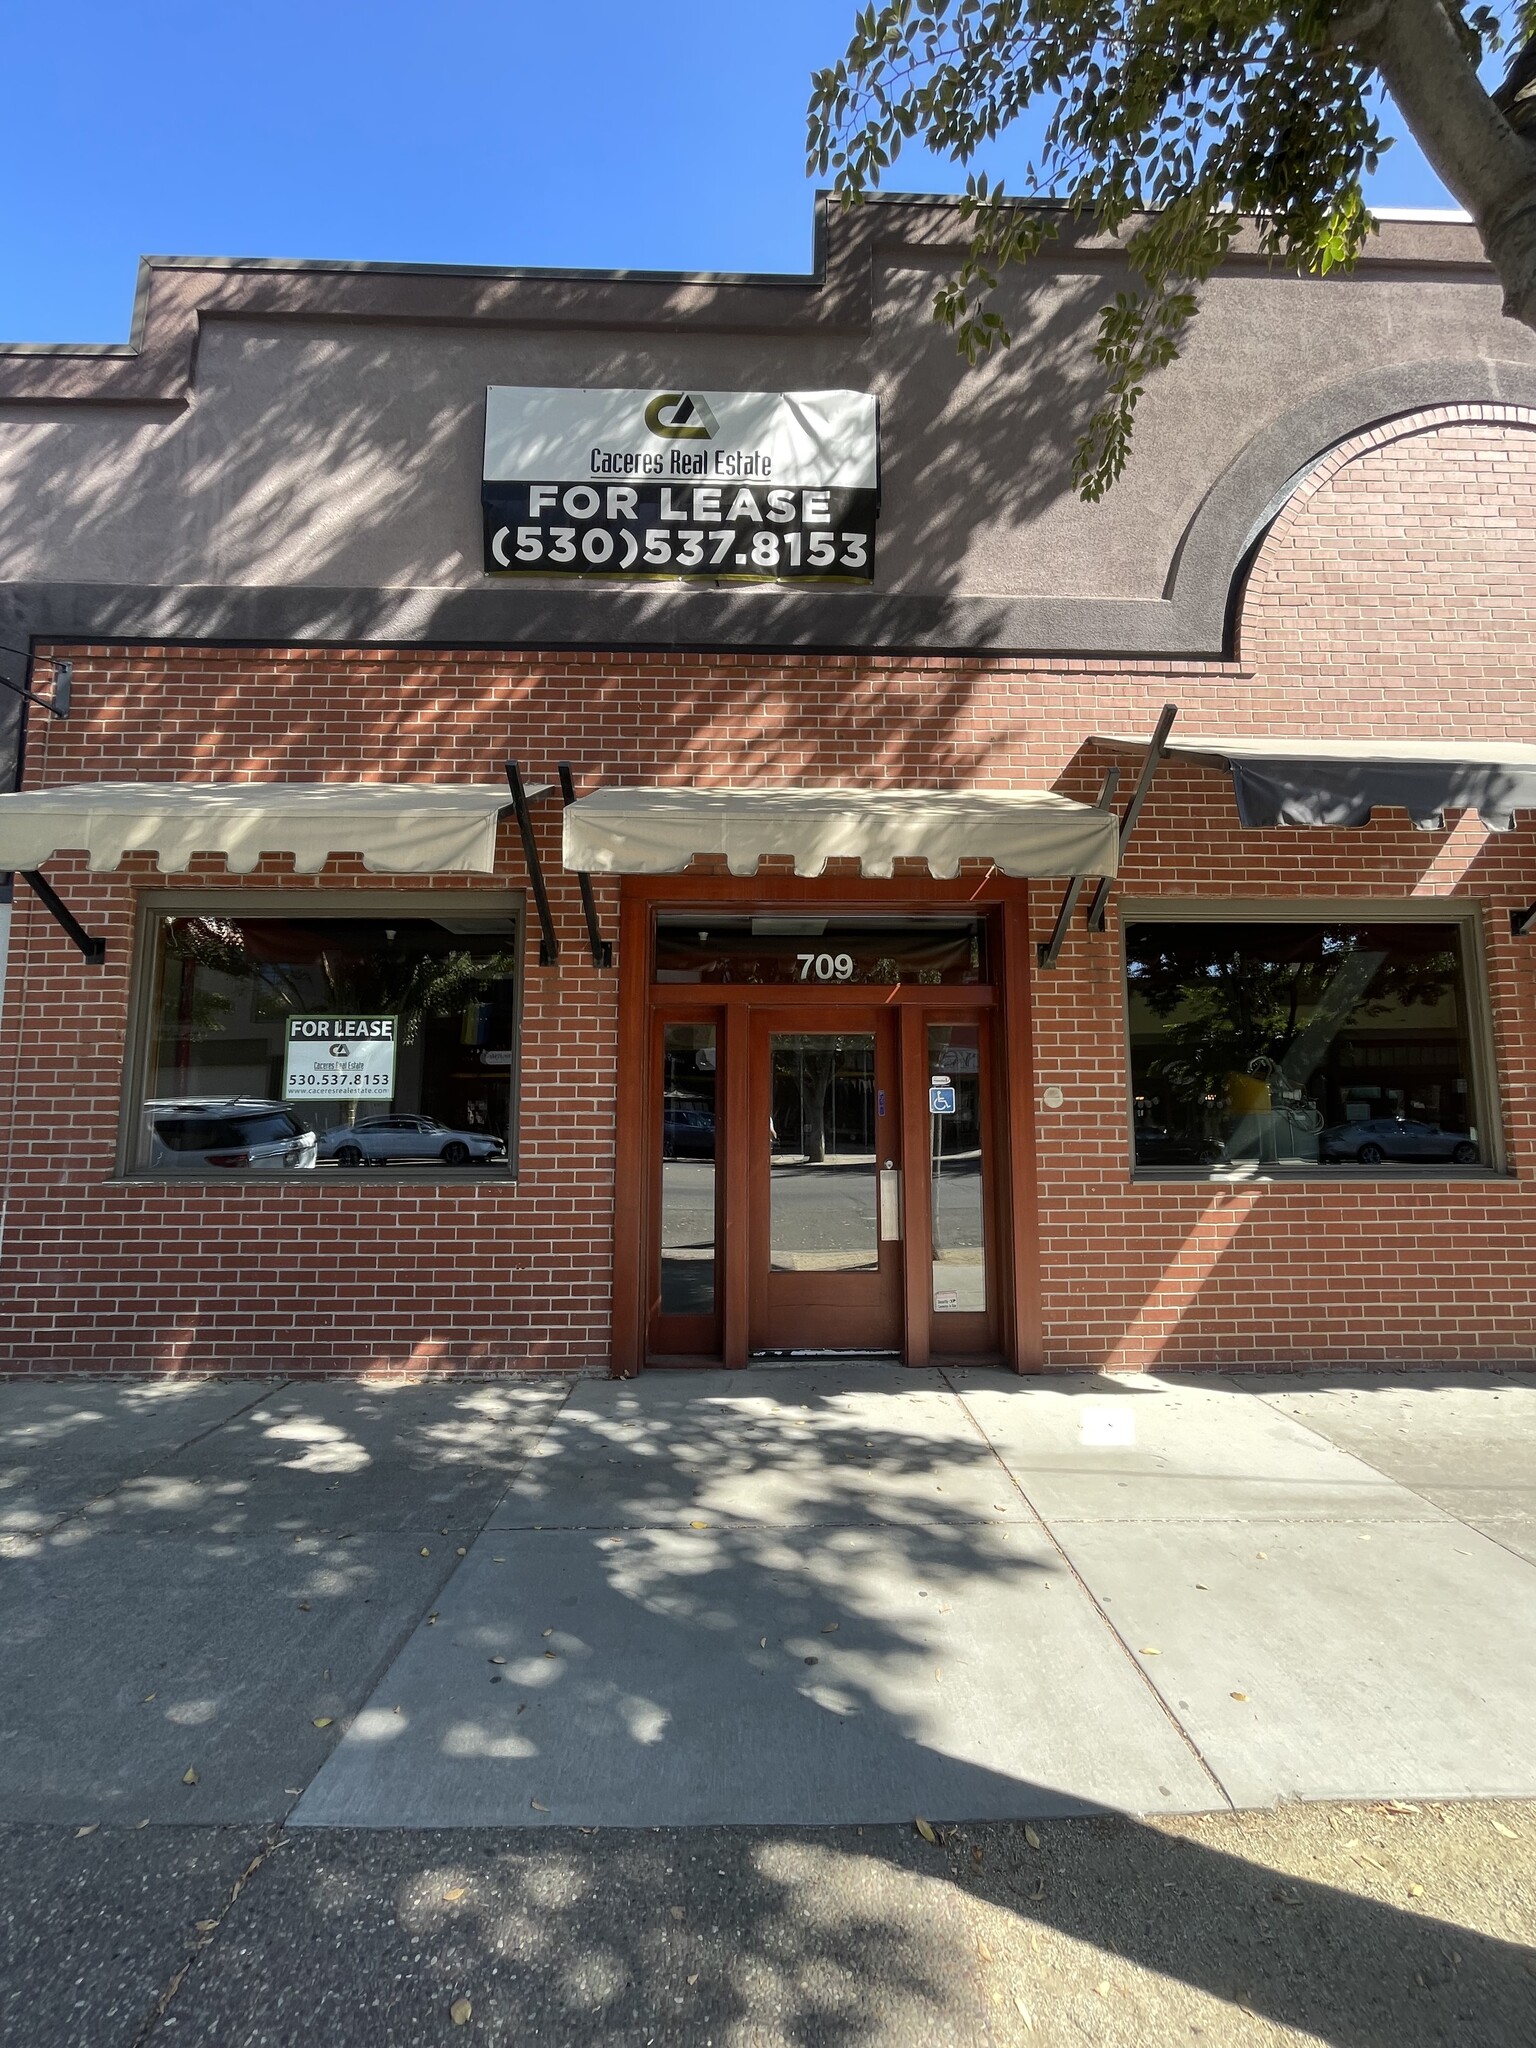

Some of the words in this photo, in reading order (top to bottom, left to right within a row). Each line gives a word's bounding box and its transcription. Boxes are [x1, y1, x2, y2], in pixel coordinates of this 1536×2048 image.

[590, 448, 664, 475] Caceres
[670, 449, 708, 475] Real
[715, 450, 772, 476] Estate
[529, 485, 639, 520] FOR
[660, 487, 832, 524] LEASE
[491, 526, 868, 570] (530)537.8153
[797, 953, 854, 980] 709
[291, 1021, 330, 1037] FOR
[334, 1021, 393, 1037] LEASE
[314, 1062, 335, 1070] Caceres
[347, 1062, 365, 1070] Estate
[289, 1074, 389, 1086] 530.537.8153
